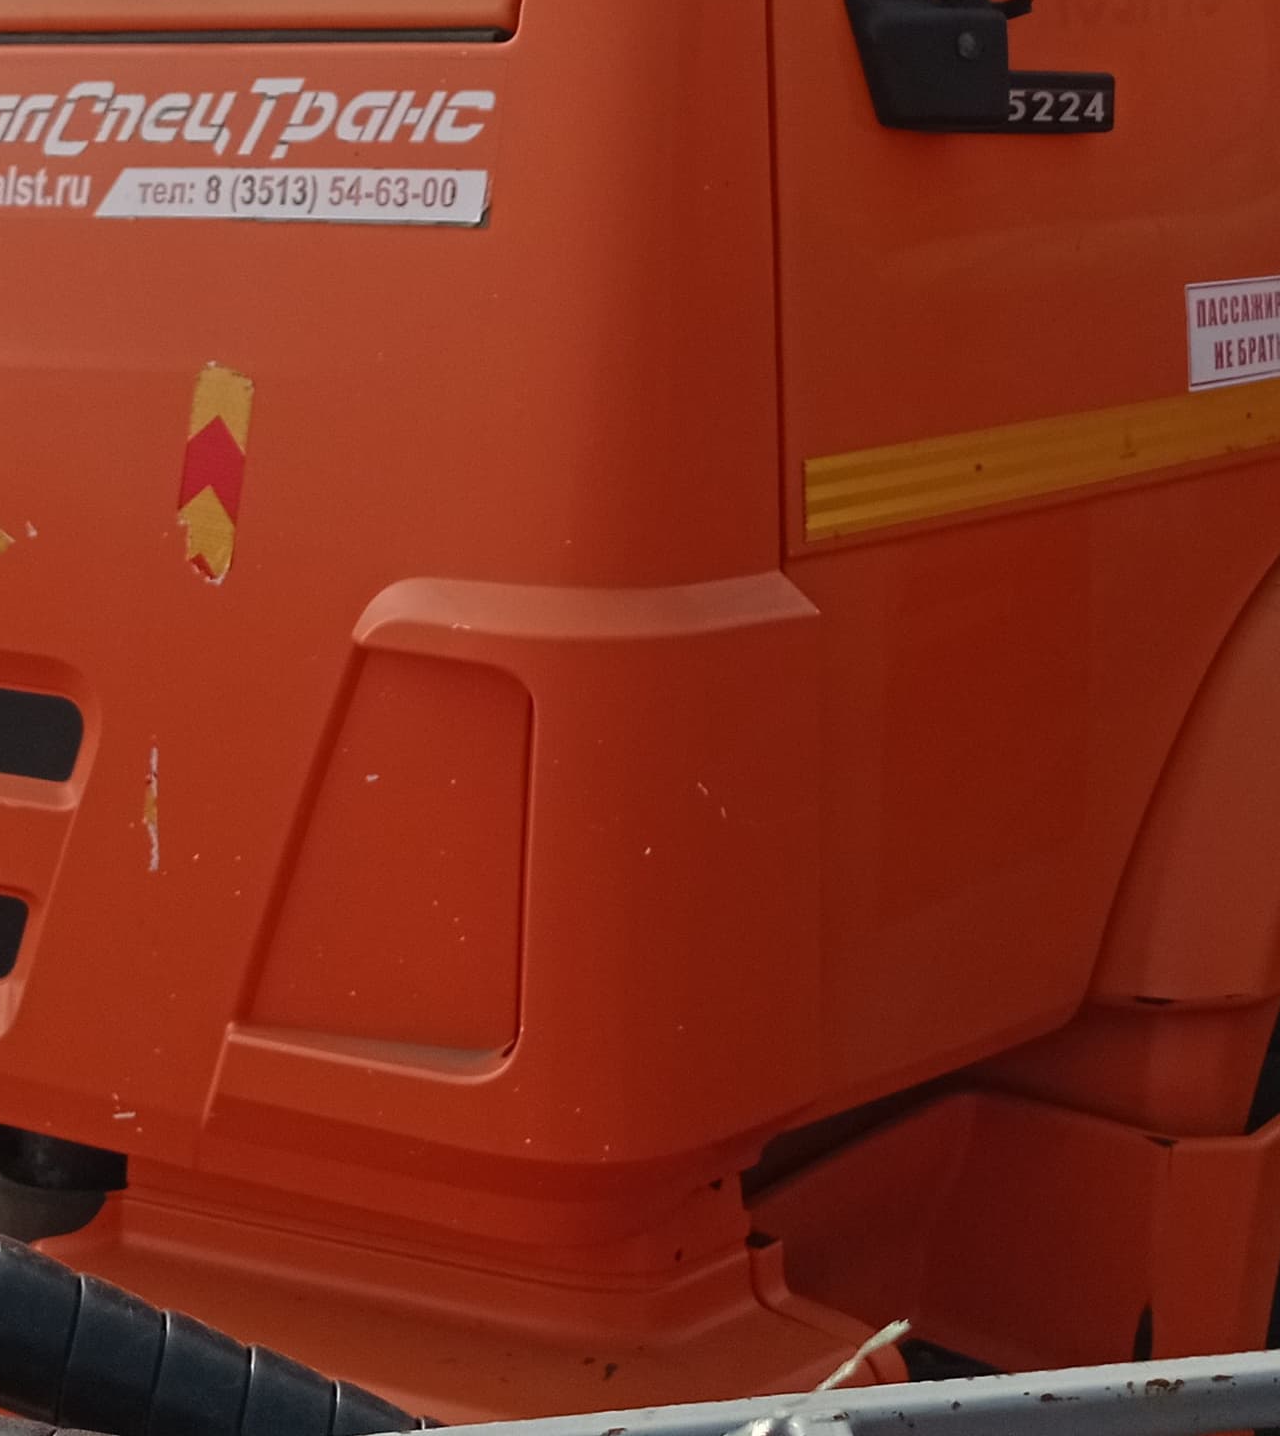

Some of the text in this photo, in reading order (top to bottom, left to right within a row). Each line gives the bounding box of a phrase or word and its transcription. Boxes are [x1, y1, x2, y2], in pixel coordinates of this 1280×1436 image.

[138, 174, 458, 213] тел: 8 (3513) 54-63-00
[1214, 339, 1233, 370] НЕ
